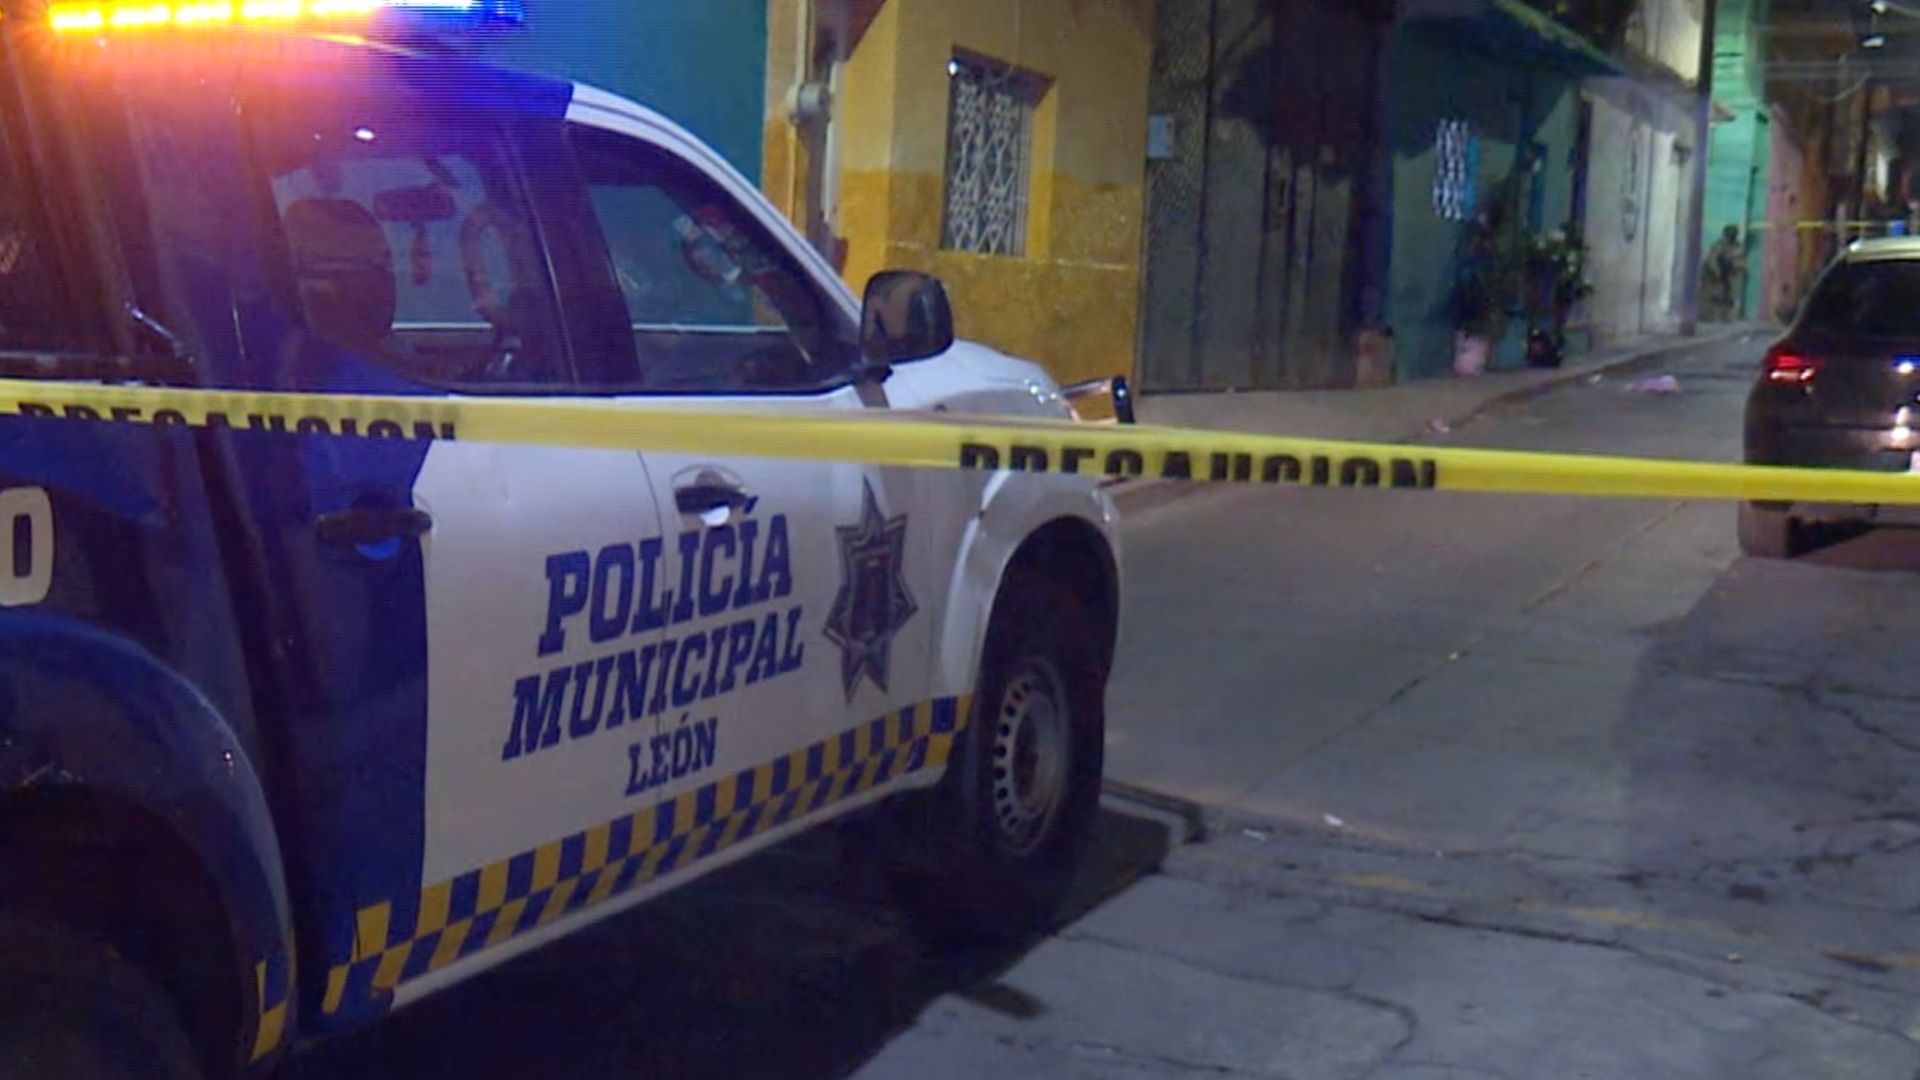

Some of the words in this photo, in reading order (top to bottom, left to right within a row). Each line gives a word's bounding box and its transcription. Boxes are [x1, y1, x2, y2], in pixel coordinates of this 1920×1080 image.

[538, 496, 792, 657] POLICÍA
[502, 606, 805, 761] MUNICIPAL
[624, 713, 718, 796] LEÓN
